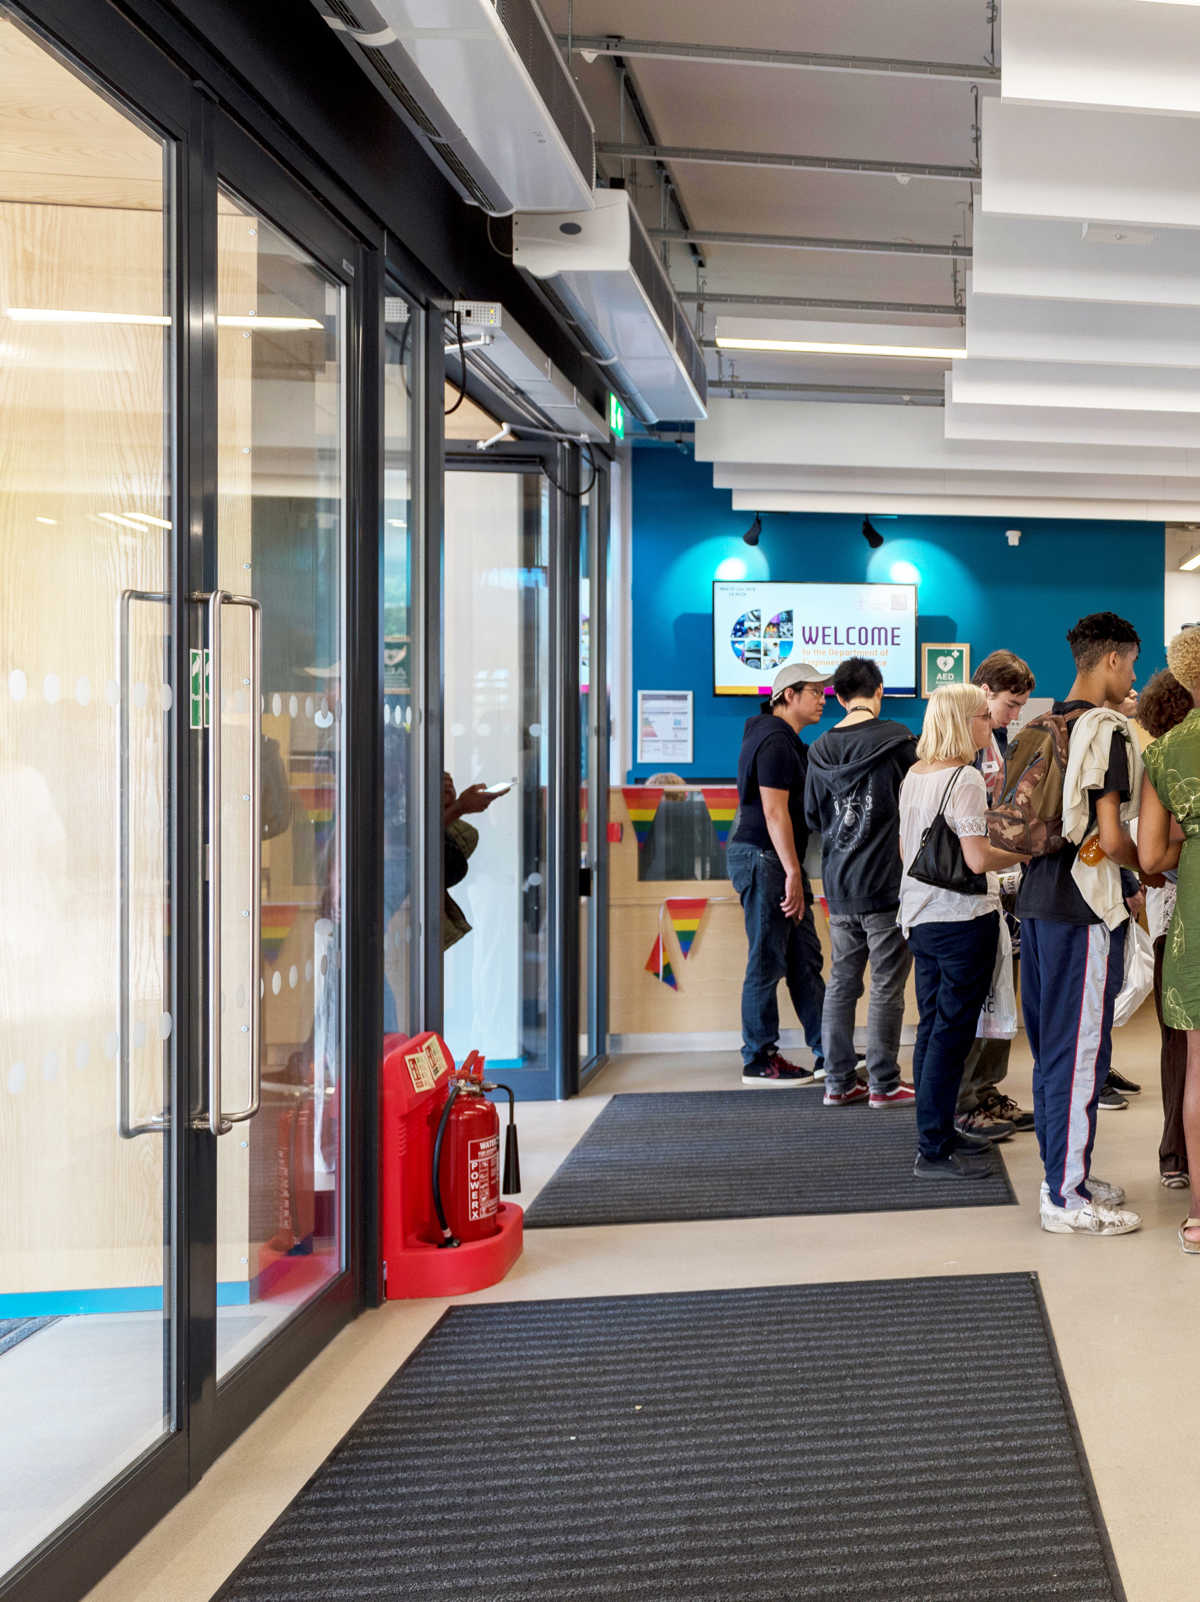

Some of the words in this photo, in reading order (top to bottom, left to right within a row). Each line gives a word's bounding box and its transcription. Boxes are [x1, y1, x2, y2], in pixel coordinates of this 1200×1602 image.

[802, 626, 901, 646] WELCOME
[813, 648, 826, 656] the
[828, 648, 881, 658] Department
[936, 672, 955, 681] AED
